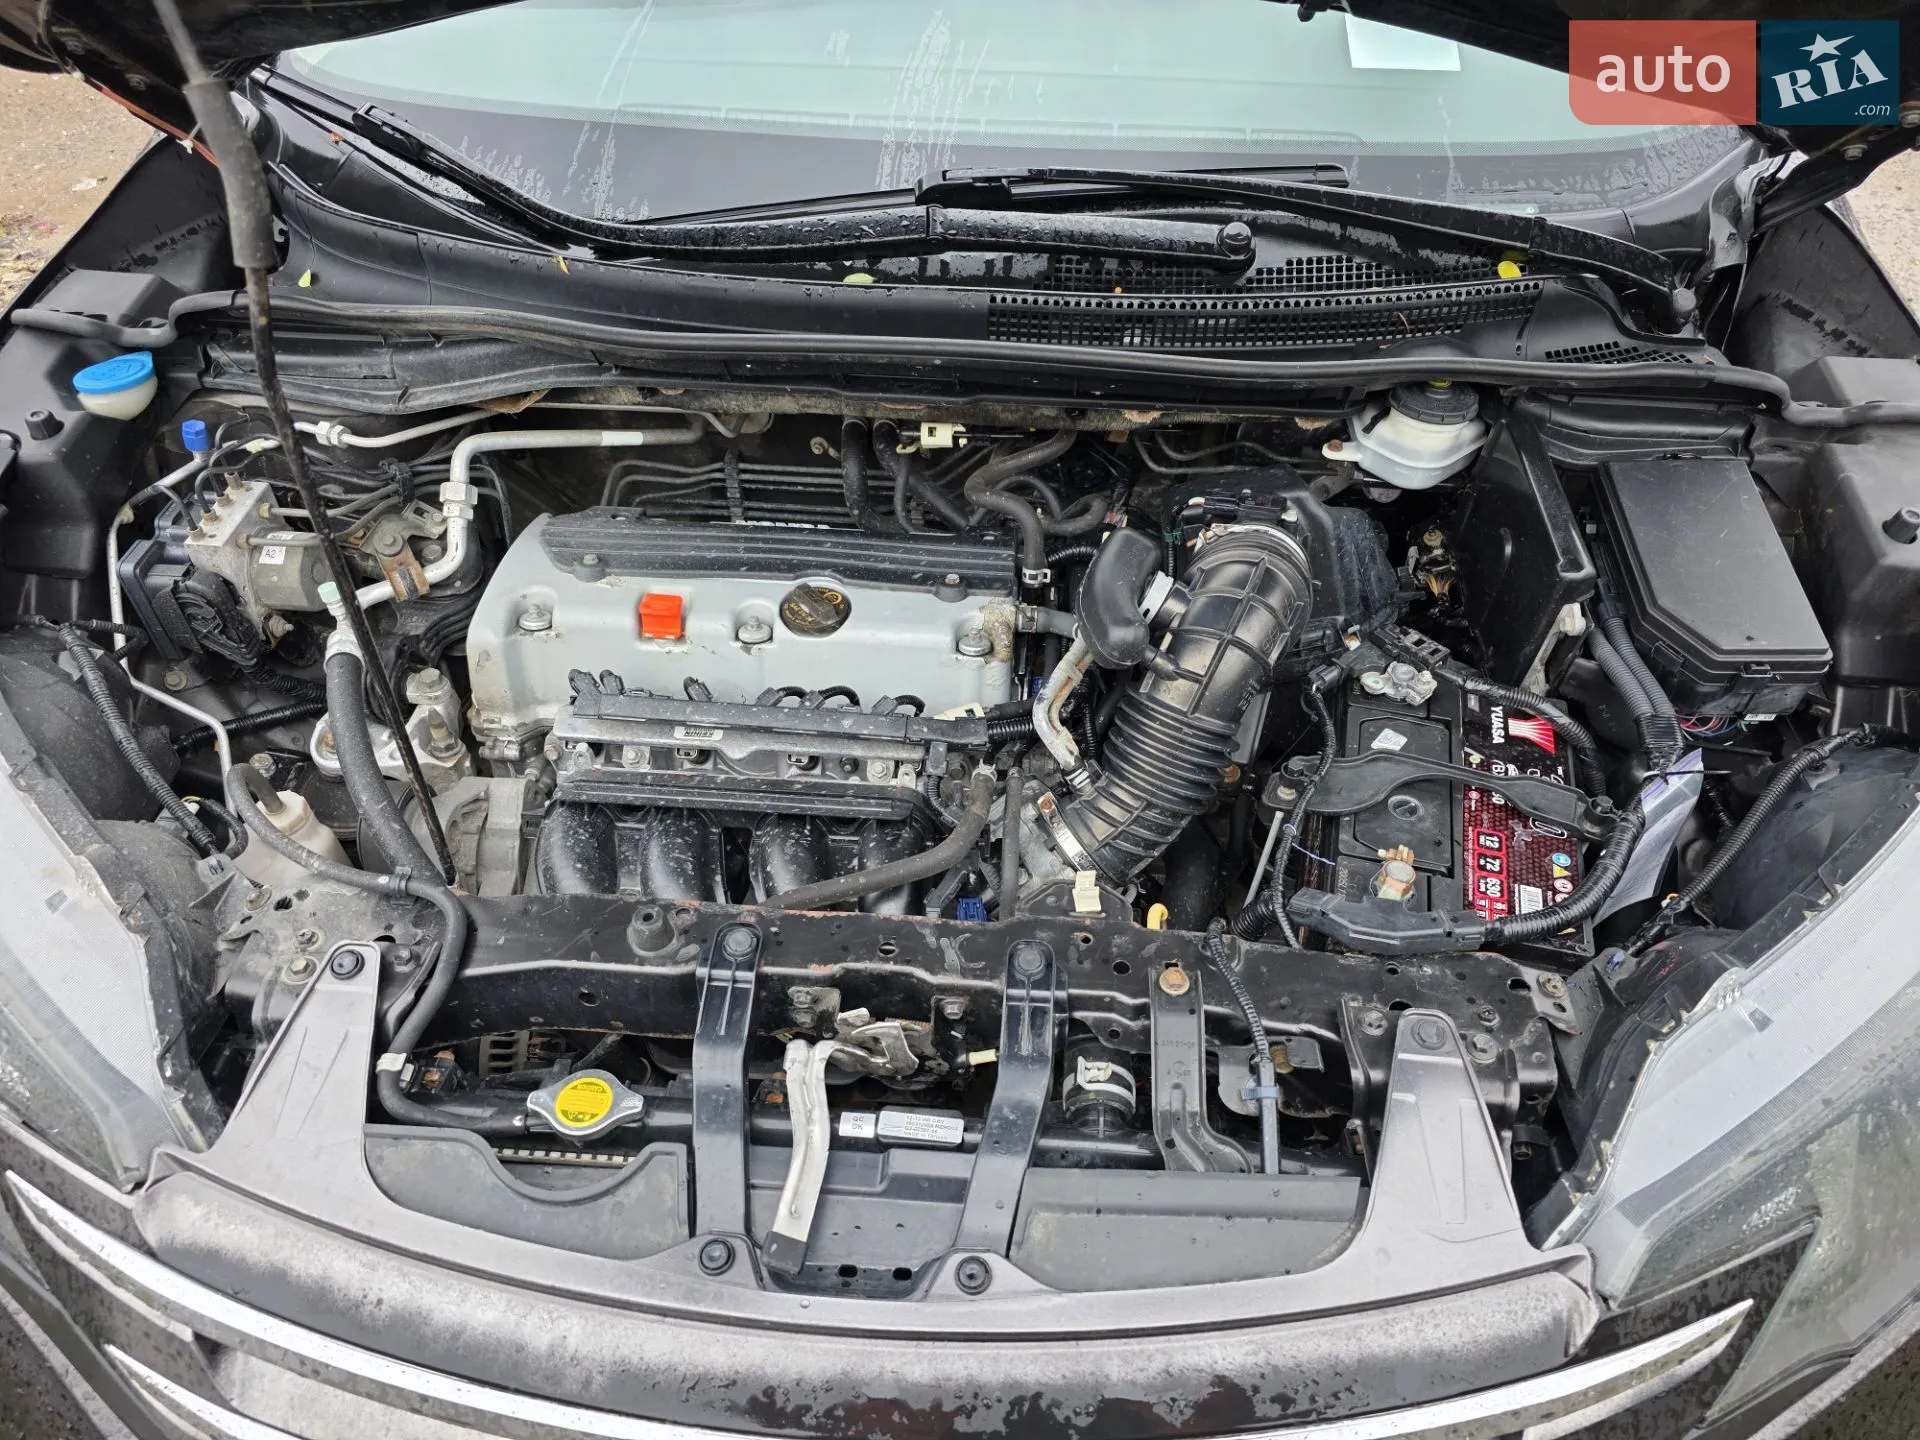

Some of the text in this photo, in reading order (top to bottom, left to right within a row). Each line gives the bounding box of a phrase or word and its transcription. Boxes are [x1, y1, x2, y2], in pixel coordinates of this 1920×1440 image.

[264, 548, 276, 558] A2
[1490, 705, 1505, 744] YUASA
[1486, 835, 1500, 848] 12
[1486, 857, 1500, 872] 72
[1486, 878, 1501, 898] 630
